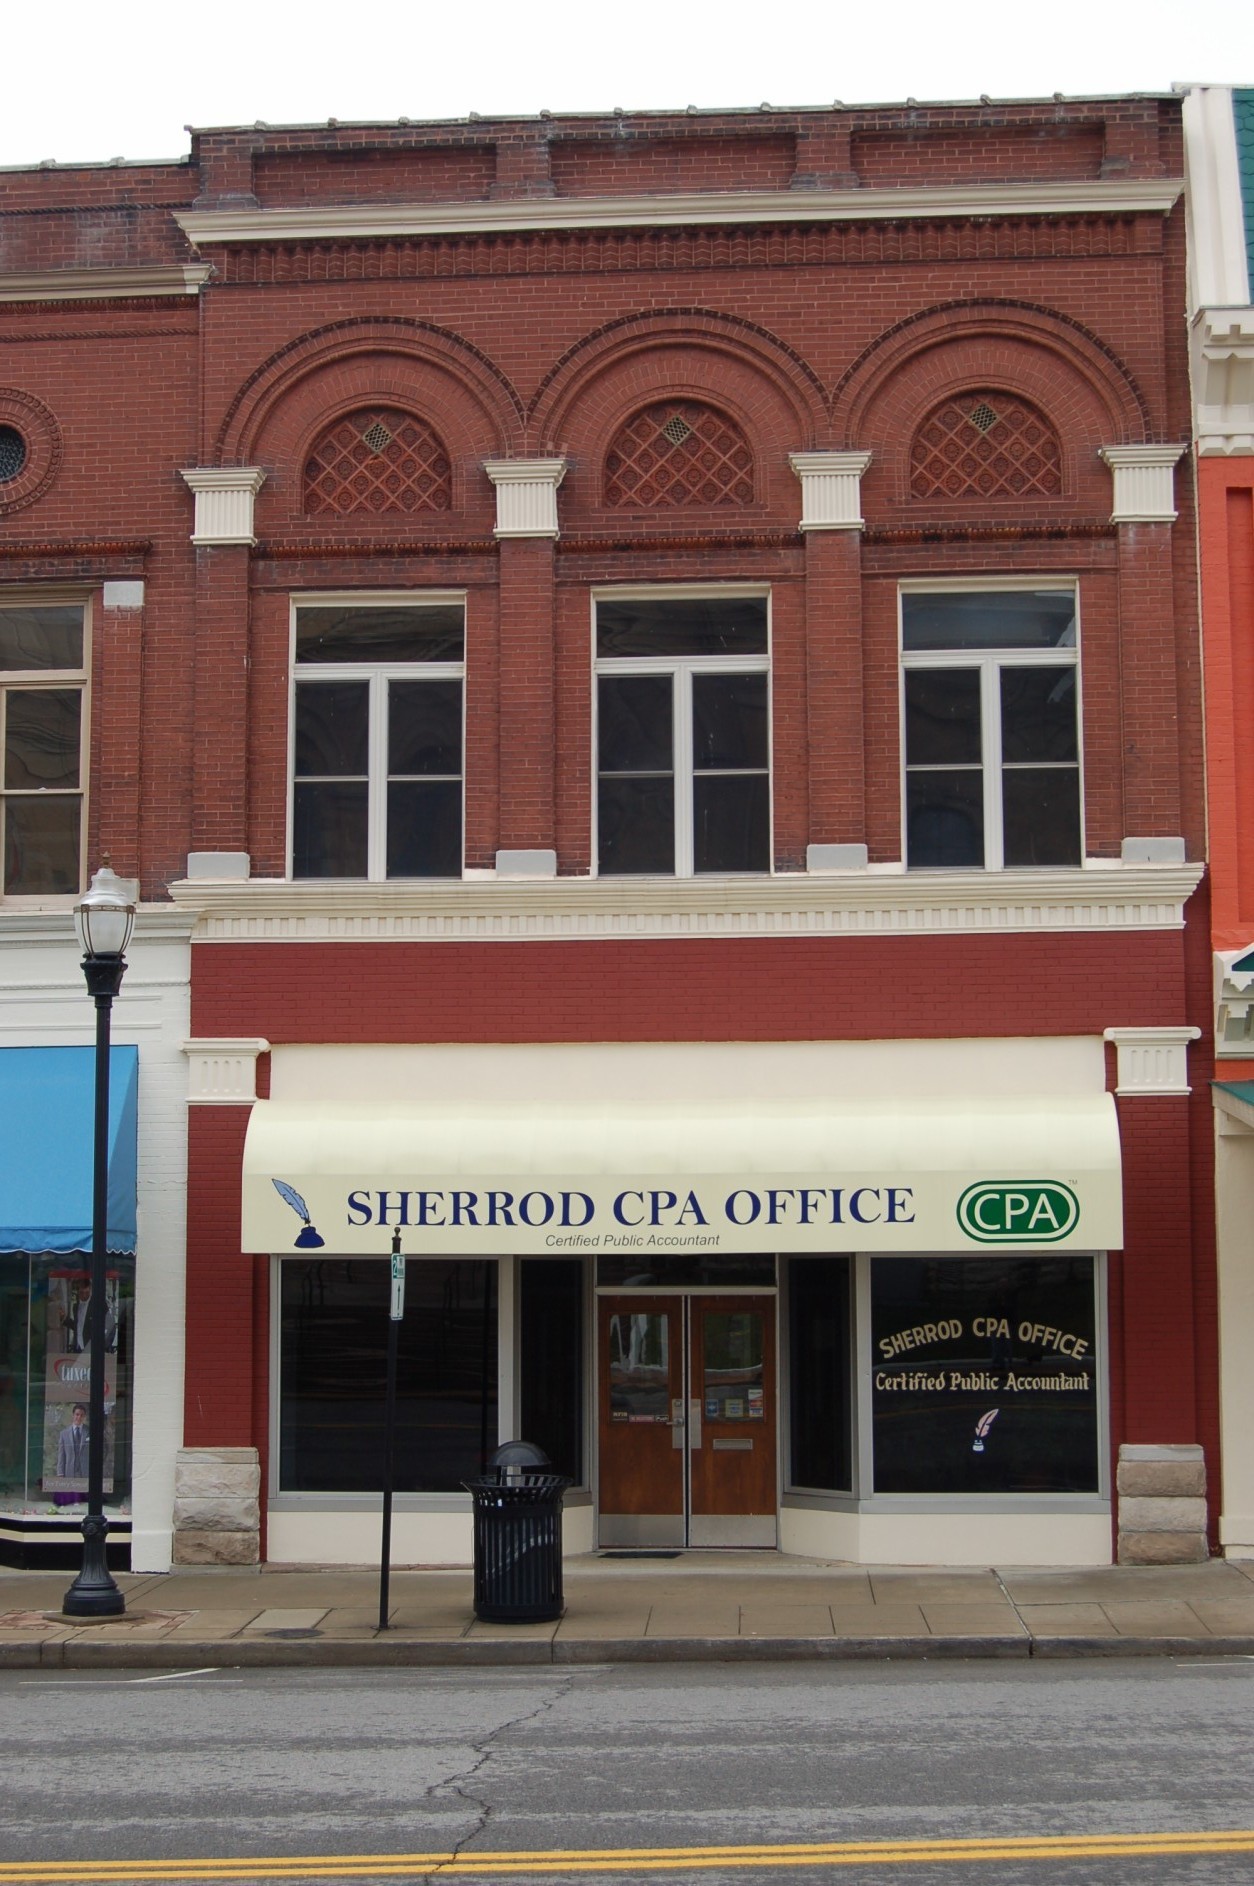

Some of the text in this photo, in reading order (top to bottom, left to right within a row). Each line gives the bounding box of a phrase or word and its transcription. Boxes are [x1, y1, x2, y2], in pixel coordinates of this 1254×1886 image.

[347, 1187, 916, 1226] SHERROD CPA OFFICE
[974, 1192, 1060, 1231] CPA
[545, 1234, 721, 1247] Certified Public Accountant
[879, 1317, 1089, 1360] SHERROD CPA OFFICE
[876, 1371, 1090, 1392] Certified Public Accountant
